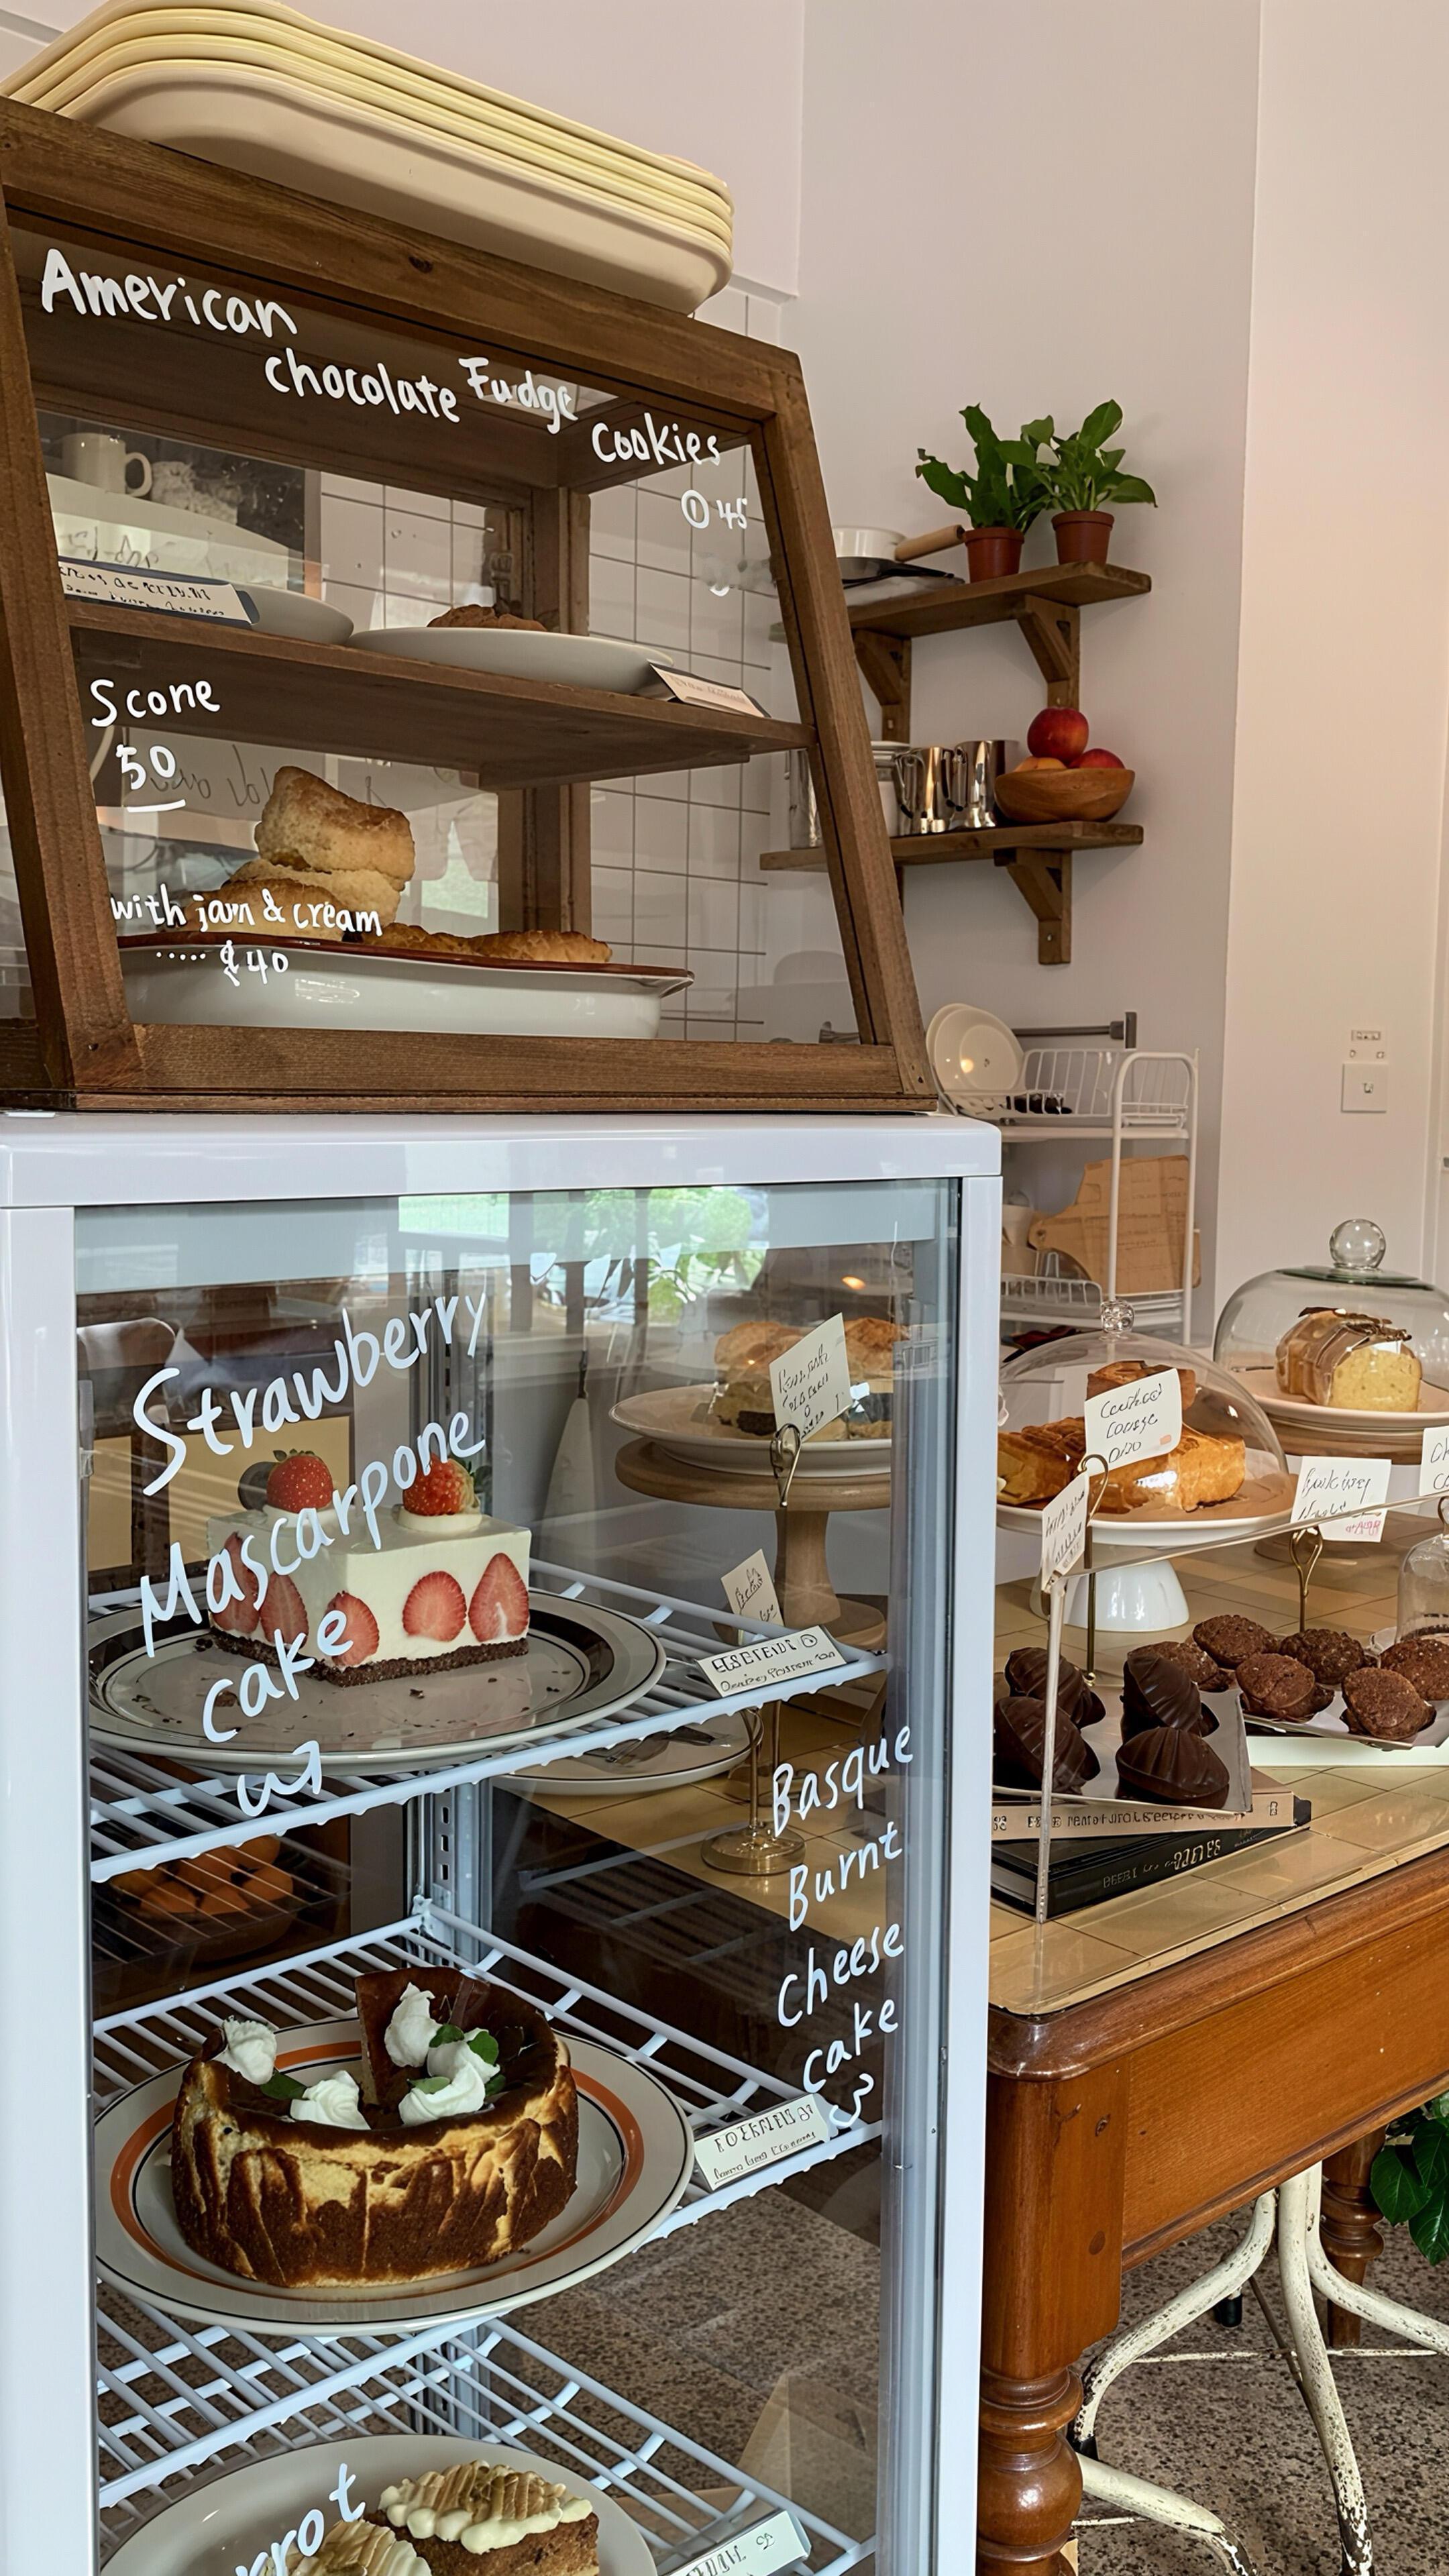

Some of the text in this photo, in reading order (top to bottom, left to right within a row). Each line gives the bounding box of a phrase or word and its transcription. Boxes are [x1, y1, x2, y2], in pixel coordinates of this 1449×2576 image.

[42, 248, 297, 337] American
[265, 347, 460, 423] chocolate
[458, 357, 578, 434] Fudge
[90, 679, 221, 727] Scone
[115, 744, 176, 790] 50
[111, 883, 383, 936] with jam & cream
[133, 1291, 488, 1497] Strawberry
[140, 1410, 487, 1658] Mascarpone
[202, 1609, 354, 1743] cake
[773, 1725, 914, 1838] Basque
[790, 1821, 903, 1931] Burnt
[778, 1923, 905, 2027] Cheese
[803, 1999, 899, 2094] cake
